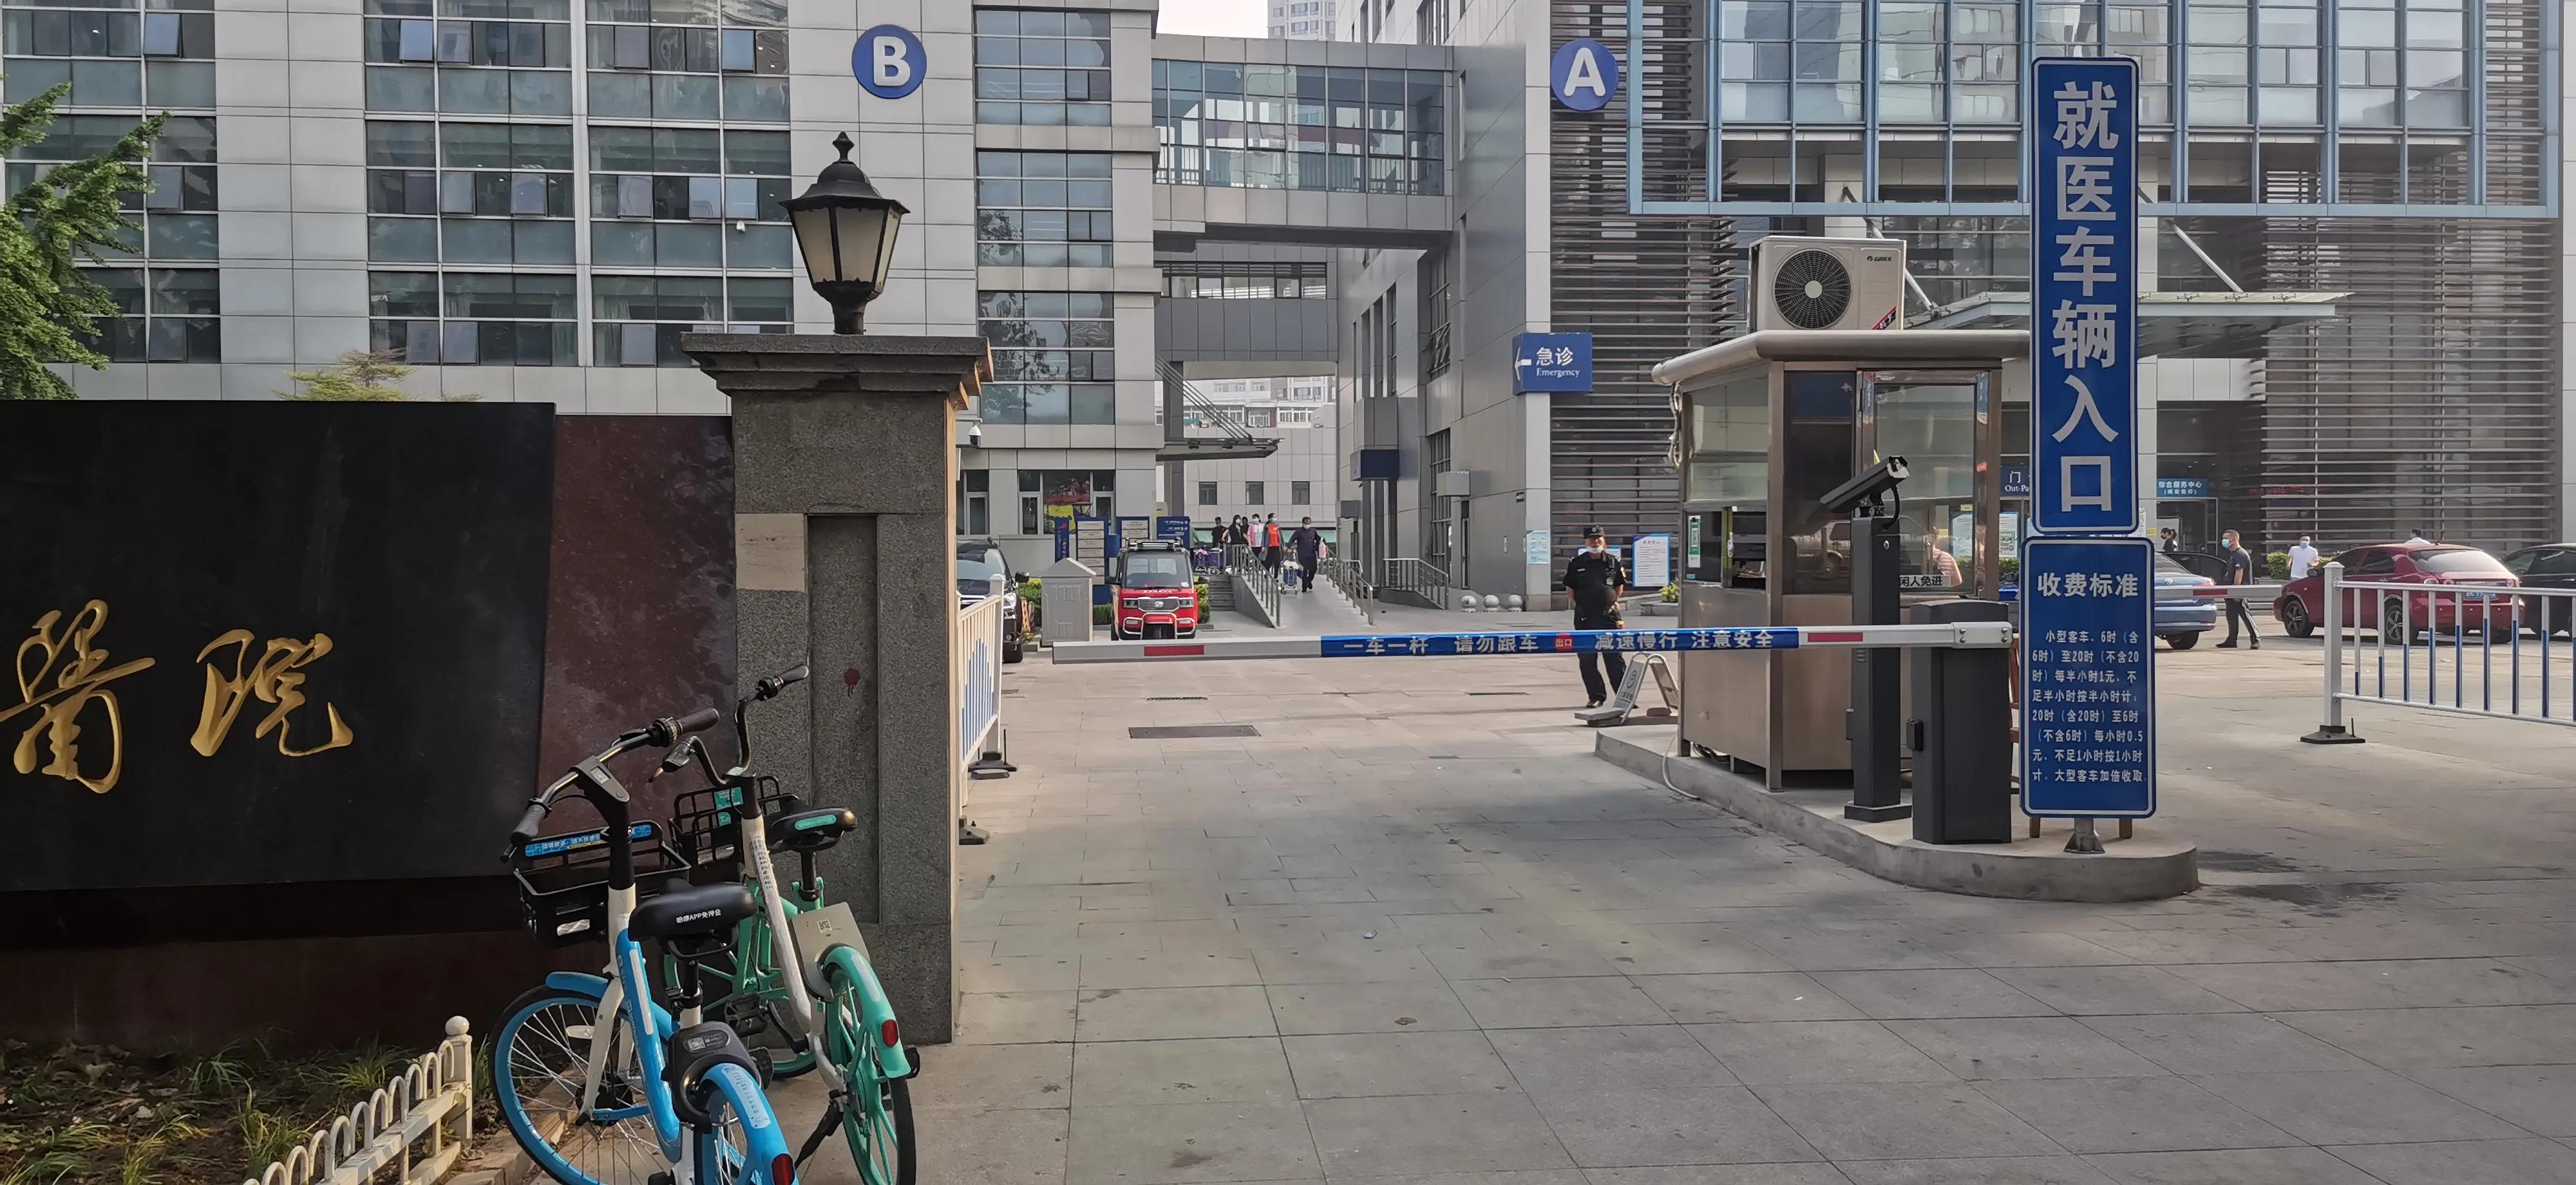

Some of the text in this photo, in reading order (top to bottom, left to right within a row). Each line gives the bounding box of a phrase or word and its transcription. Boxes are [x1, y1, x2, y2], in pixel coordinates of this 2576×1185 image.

[873, 36, 911, 86] B
[1564, 47, 1606, 97] A
[2052, 81, 2119, 513] 就医车辆入口
[1536, 347, 1573, 366] 急诊
[1536, 368, 1580, 378] Emergency
[2036, 572, 2139, 598] 收费标准
[1344, 636, 1430, 656] 一车一杆
[1454, 634, 1539, 654] 请勿跟车
[1595, 631, 1679, 650] 减速慢行
[1690, 629, 1774, 649] 注意安全
